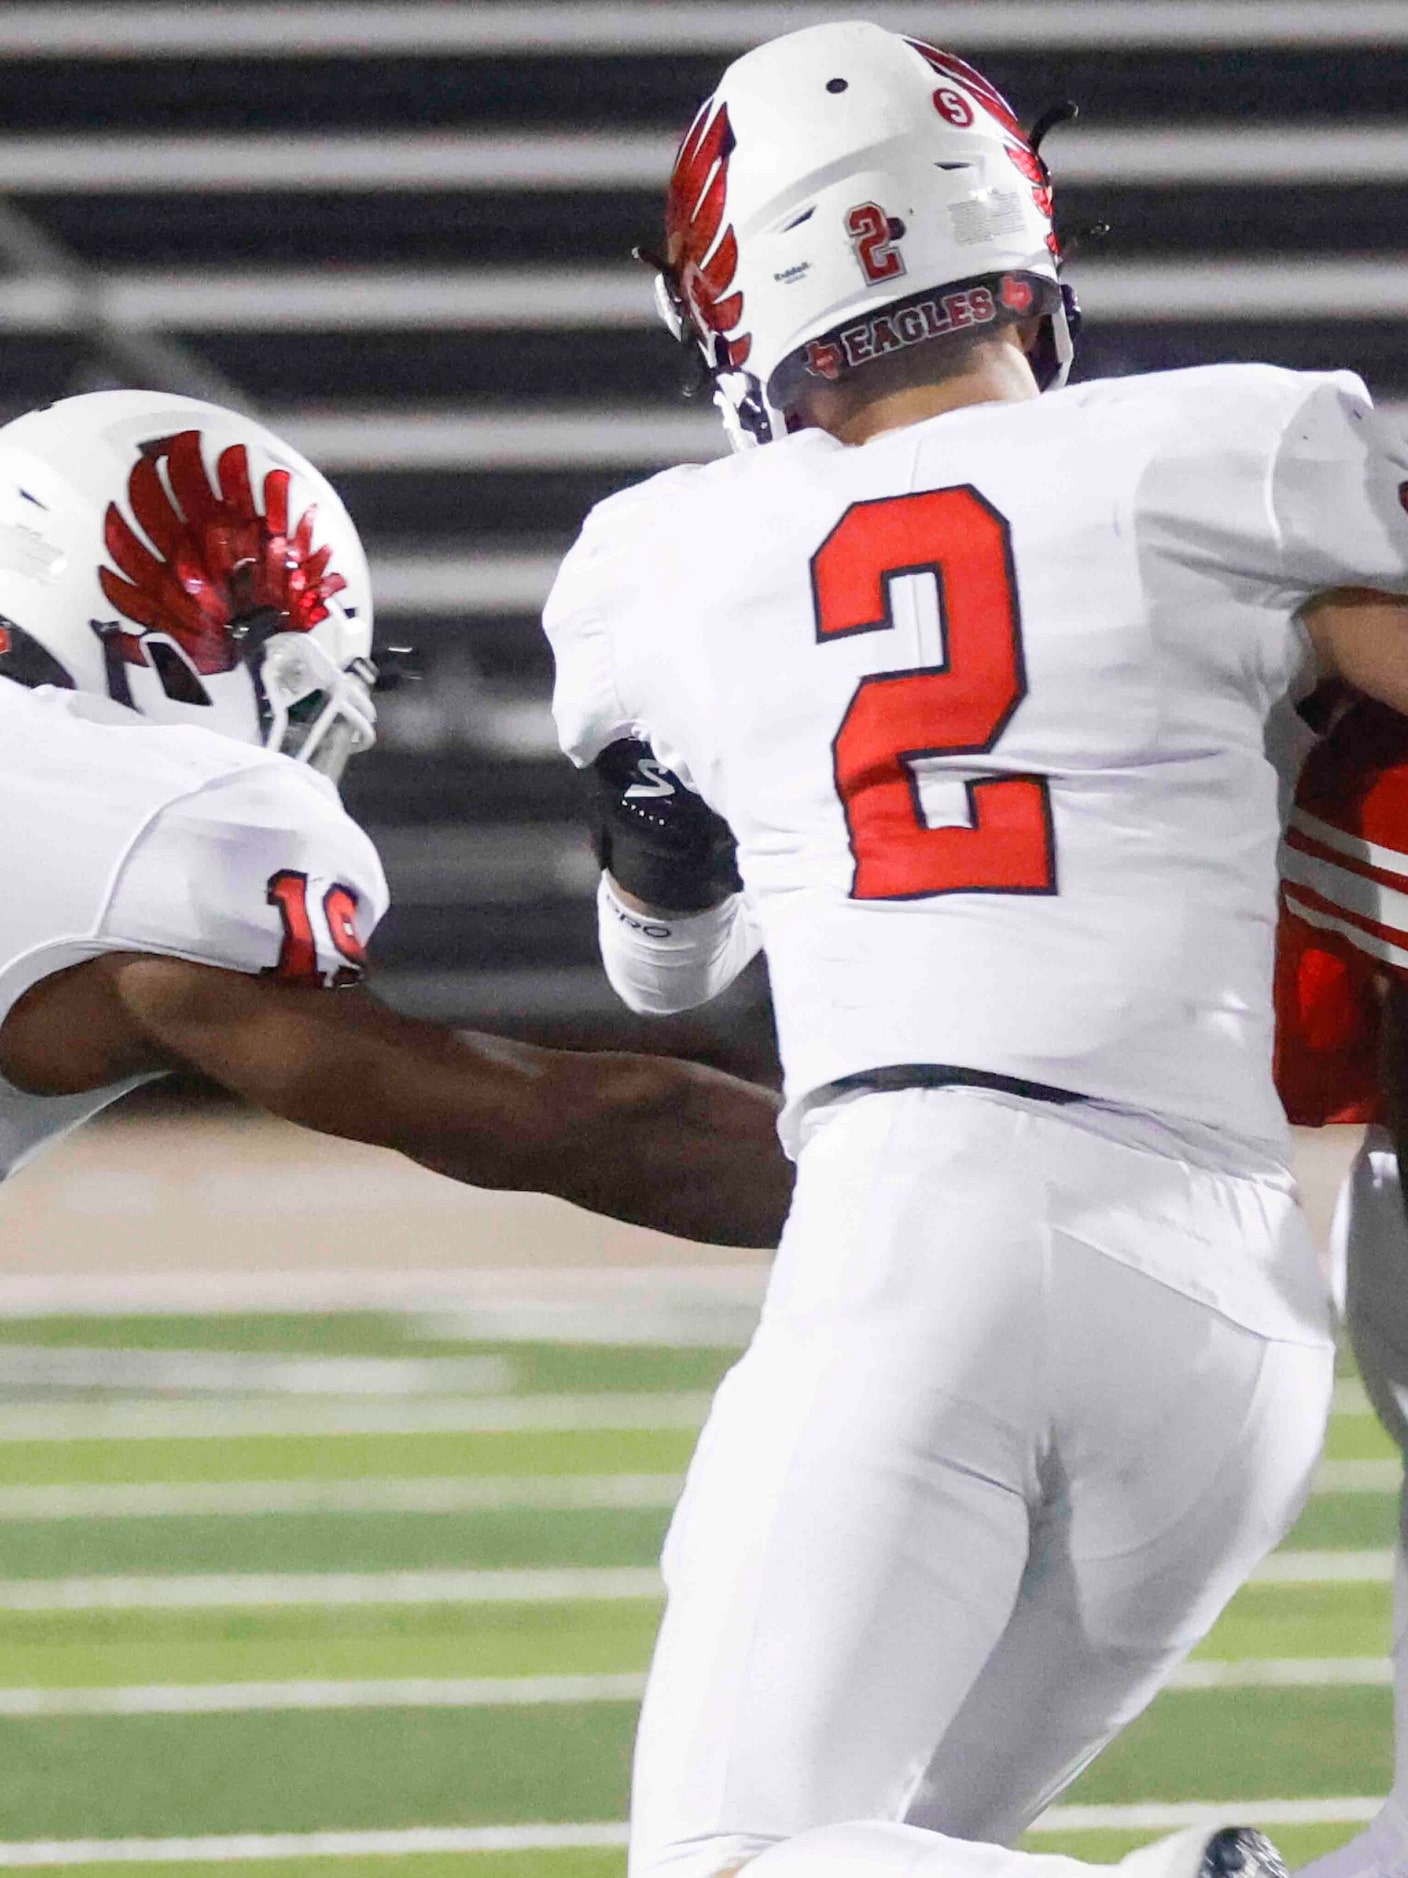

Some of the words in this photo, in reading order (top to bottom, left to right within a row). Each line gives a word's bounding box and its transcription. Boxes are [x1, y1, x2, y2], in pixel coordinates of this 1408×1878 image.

[843, 201, 908, 287] 2
[840, 287, 997, 367] EAGLES
[809, 483, 1059, 901] 2
